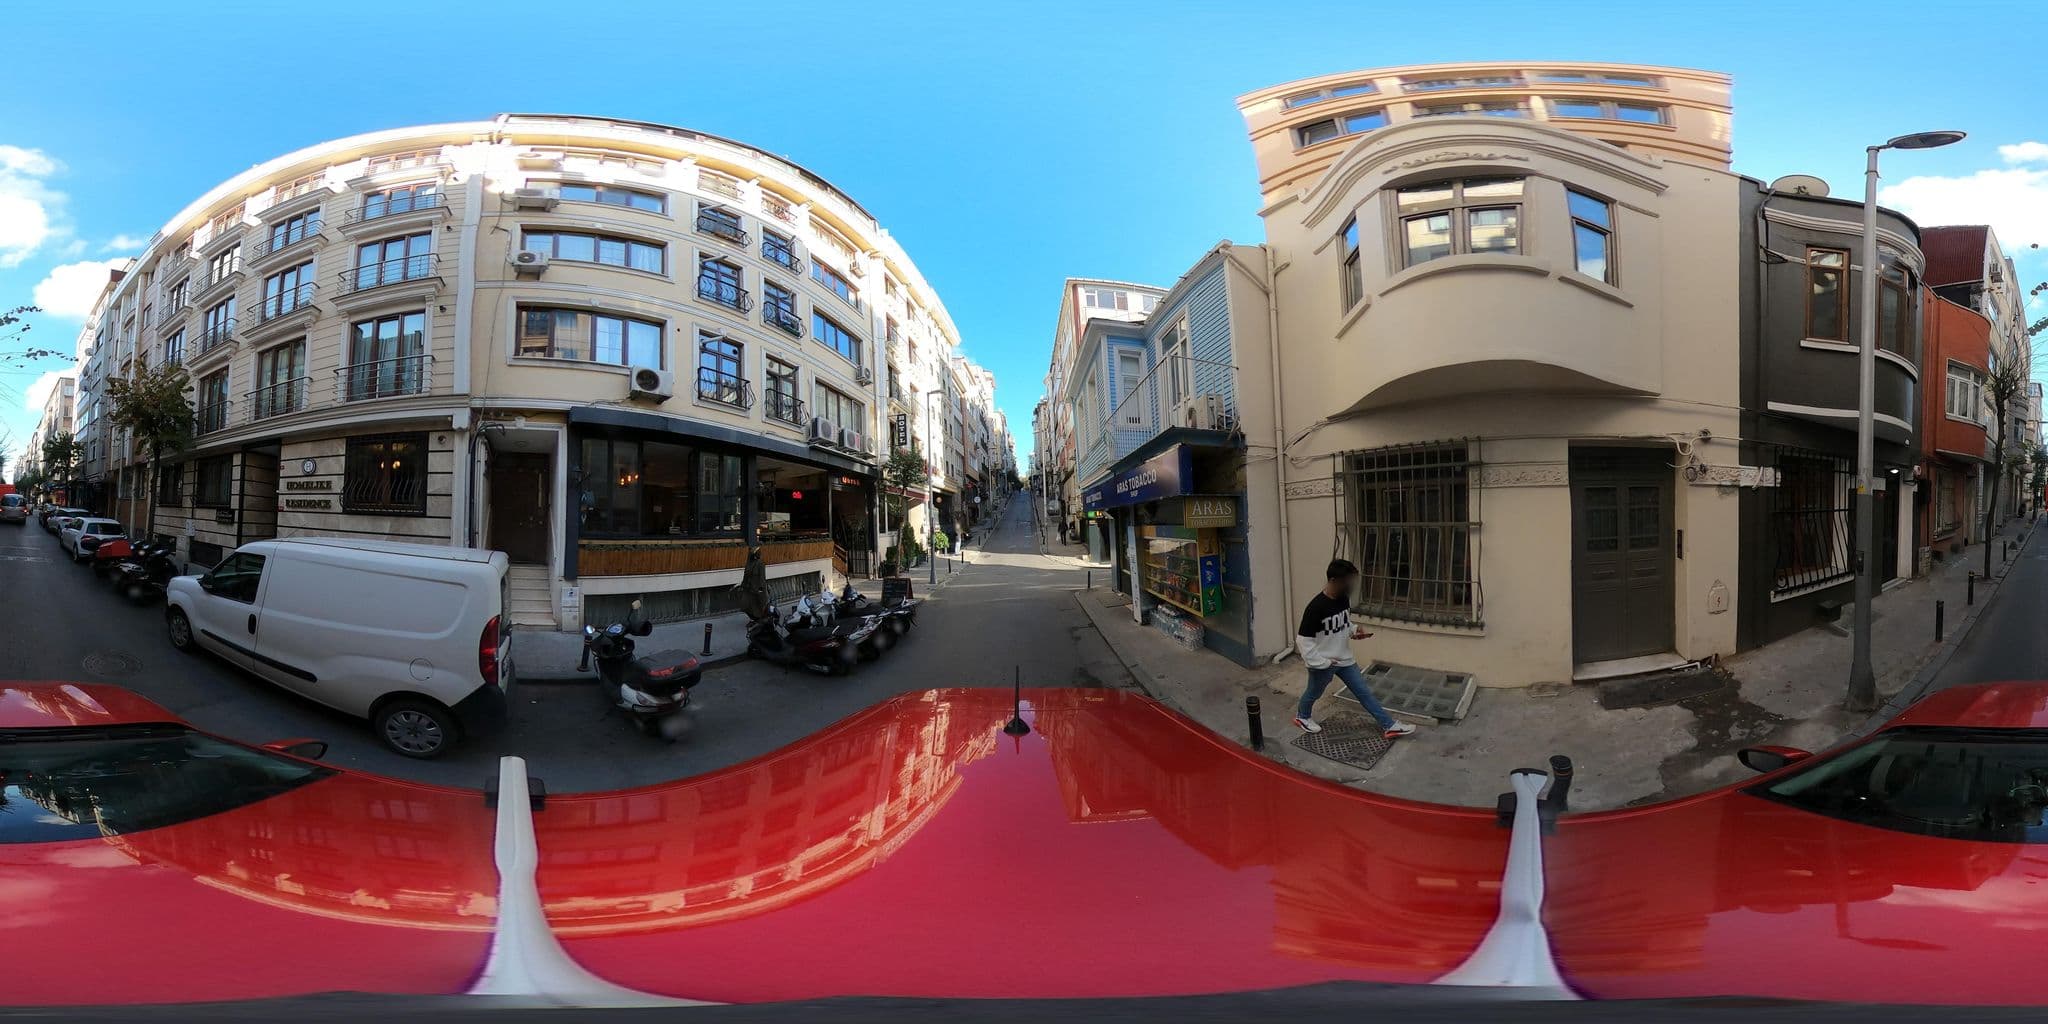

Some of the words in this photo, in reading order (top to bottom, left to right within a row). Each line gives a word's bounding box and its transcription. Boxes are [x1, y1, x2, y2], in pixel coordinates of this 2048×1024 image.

[286, 480, 332, 490] HOMELIKE
[1116, 480, 1129, 494] ARAS
[1128, 469, 1157, 490] TOBACCO
[285, 499, 331, 509] RESIDENCE
[1192, 500, 1232, 516] ARAS
